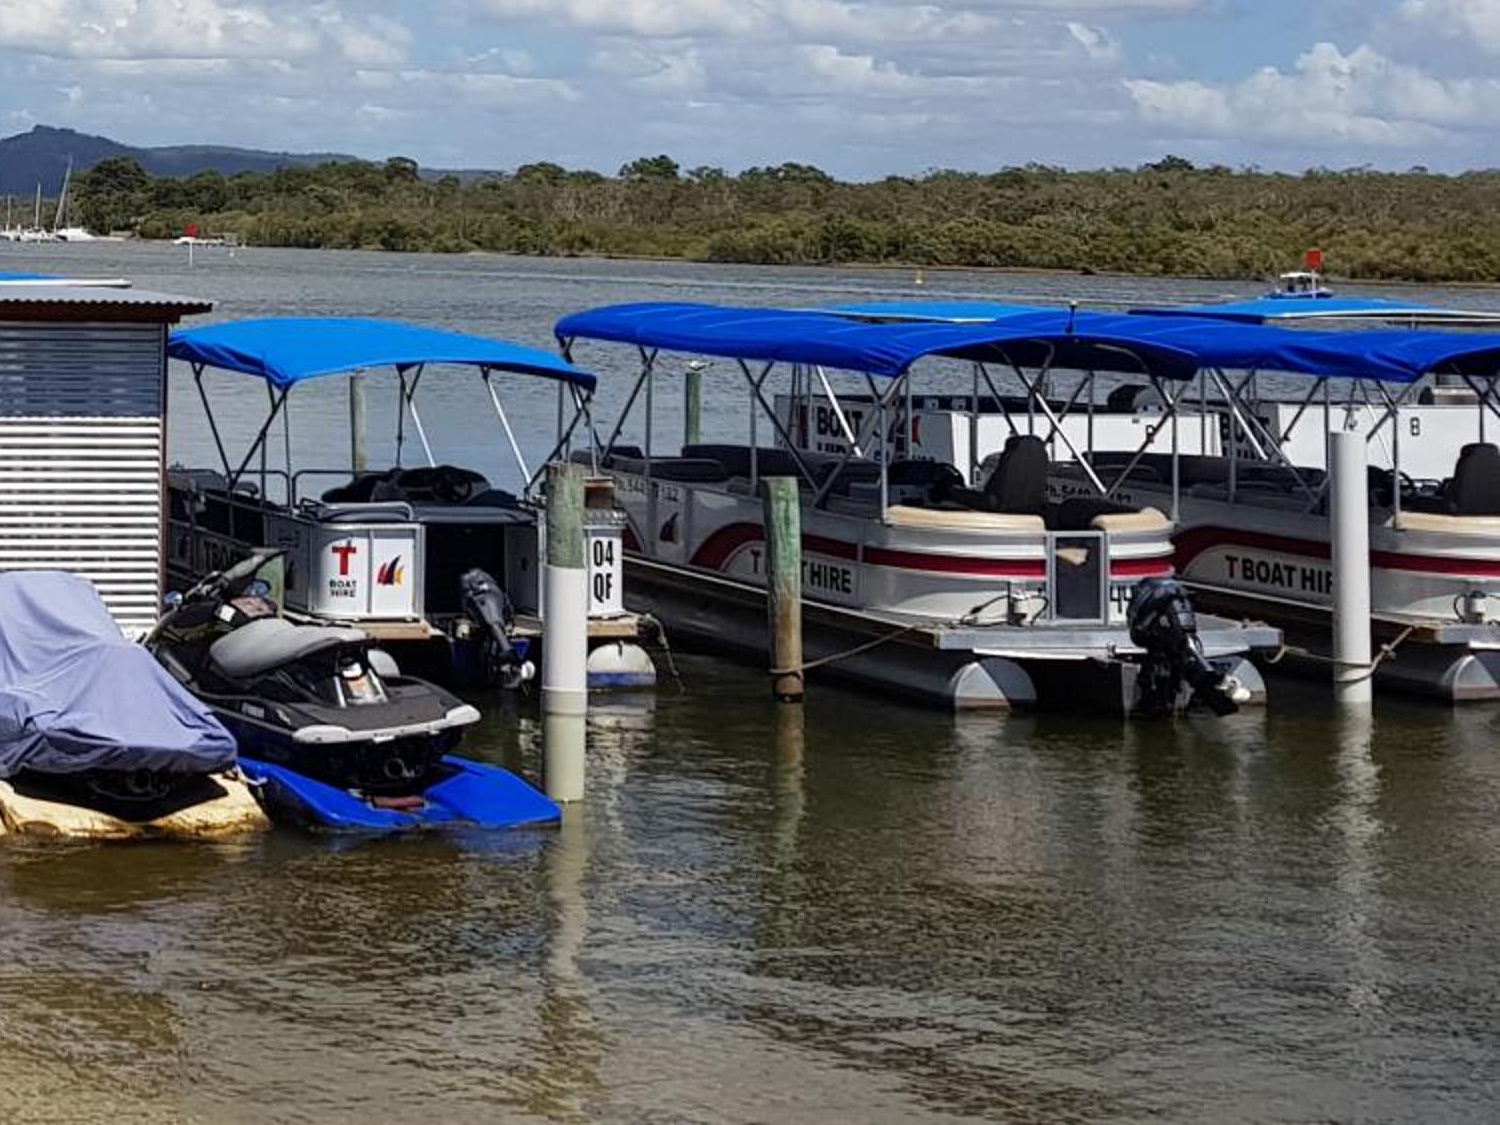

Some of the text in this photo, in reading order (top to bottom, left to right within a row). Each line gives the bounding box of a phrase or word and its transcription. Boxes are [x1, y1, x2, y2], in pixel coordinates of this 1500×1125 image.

[329, 579, 357, 588] BOAT
[809, 561, 852, 594] HIRE
[1224, 555, 1238, 579] T
[1241, 558, 1297, 588] BOAT
[331, 589, 357, 597] HIRE
[593, 572, 613, 604] QF
